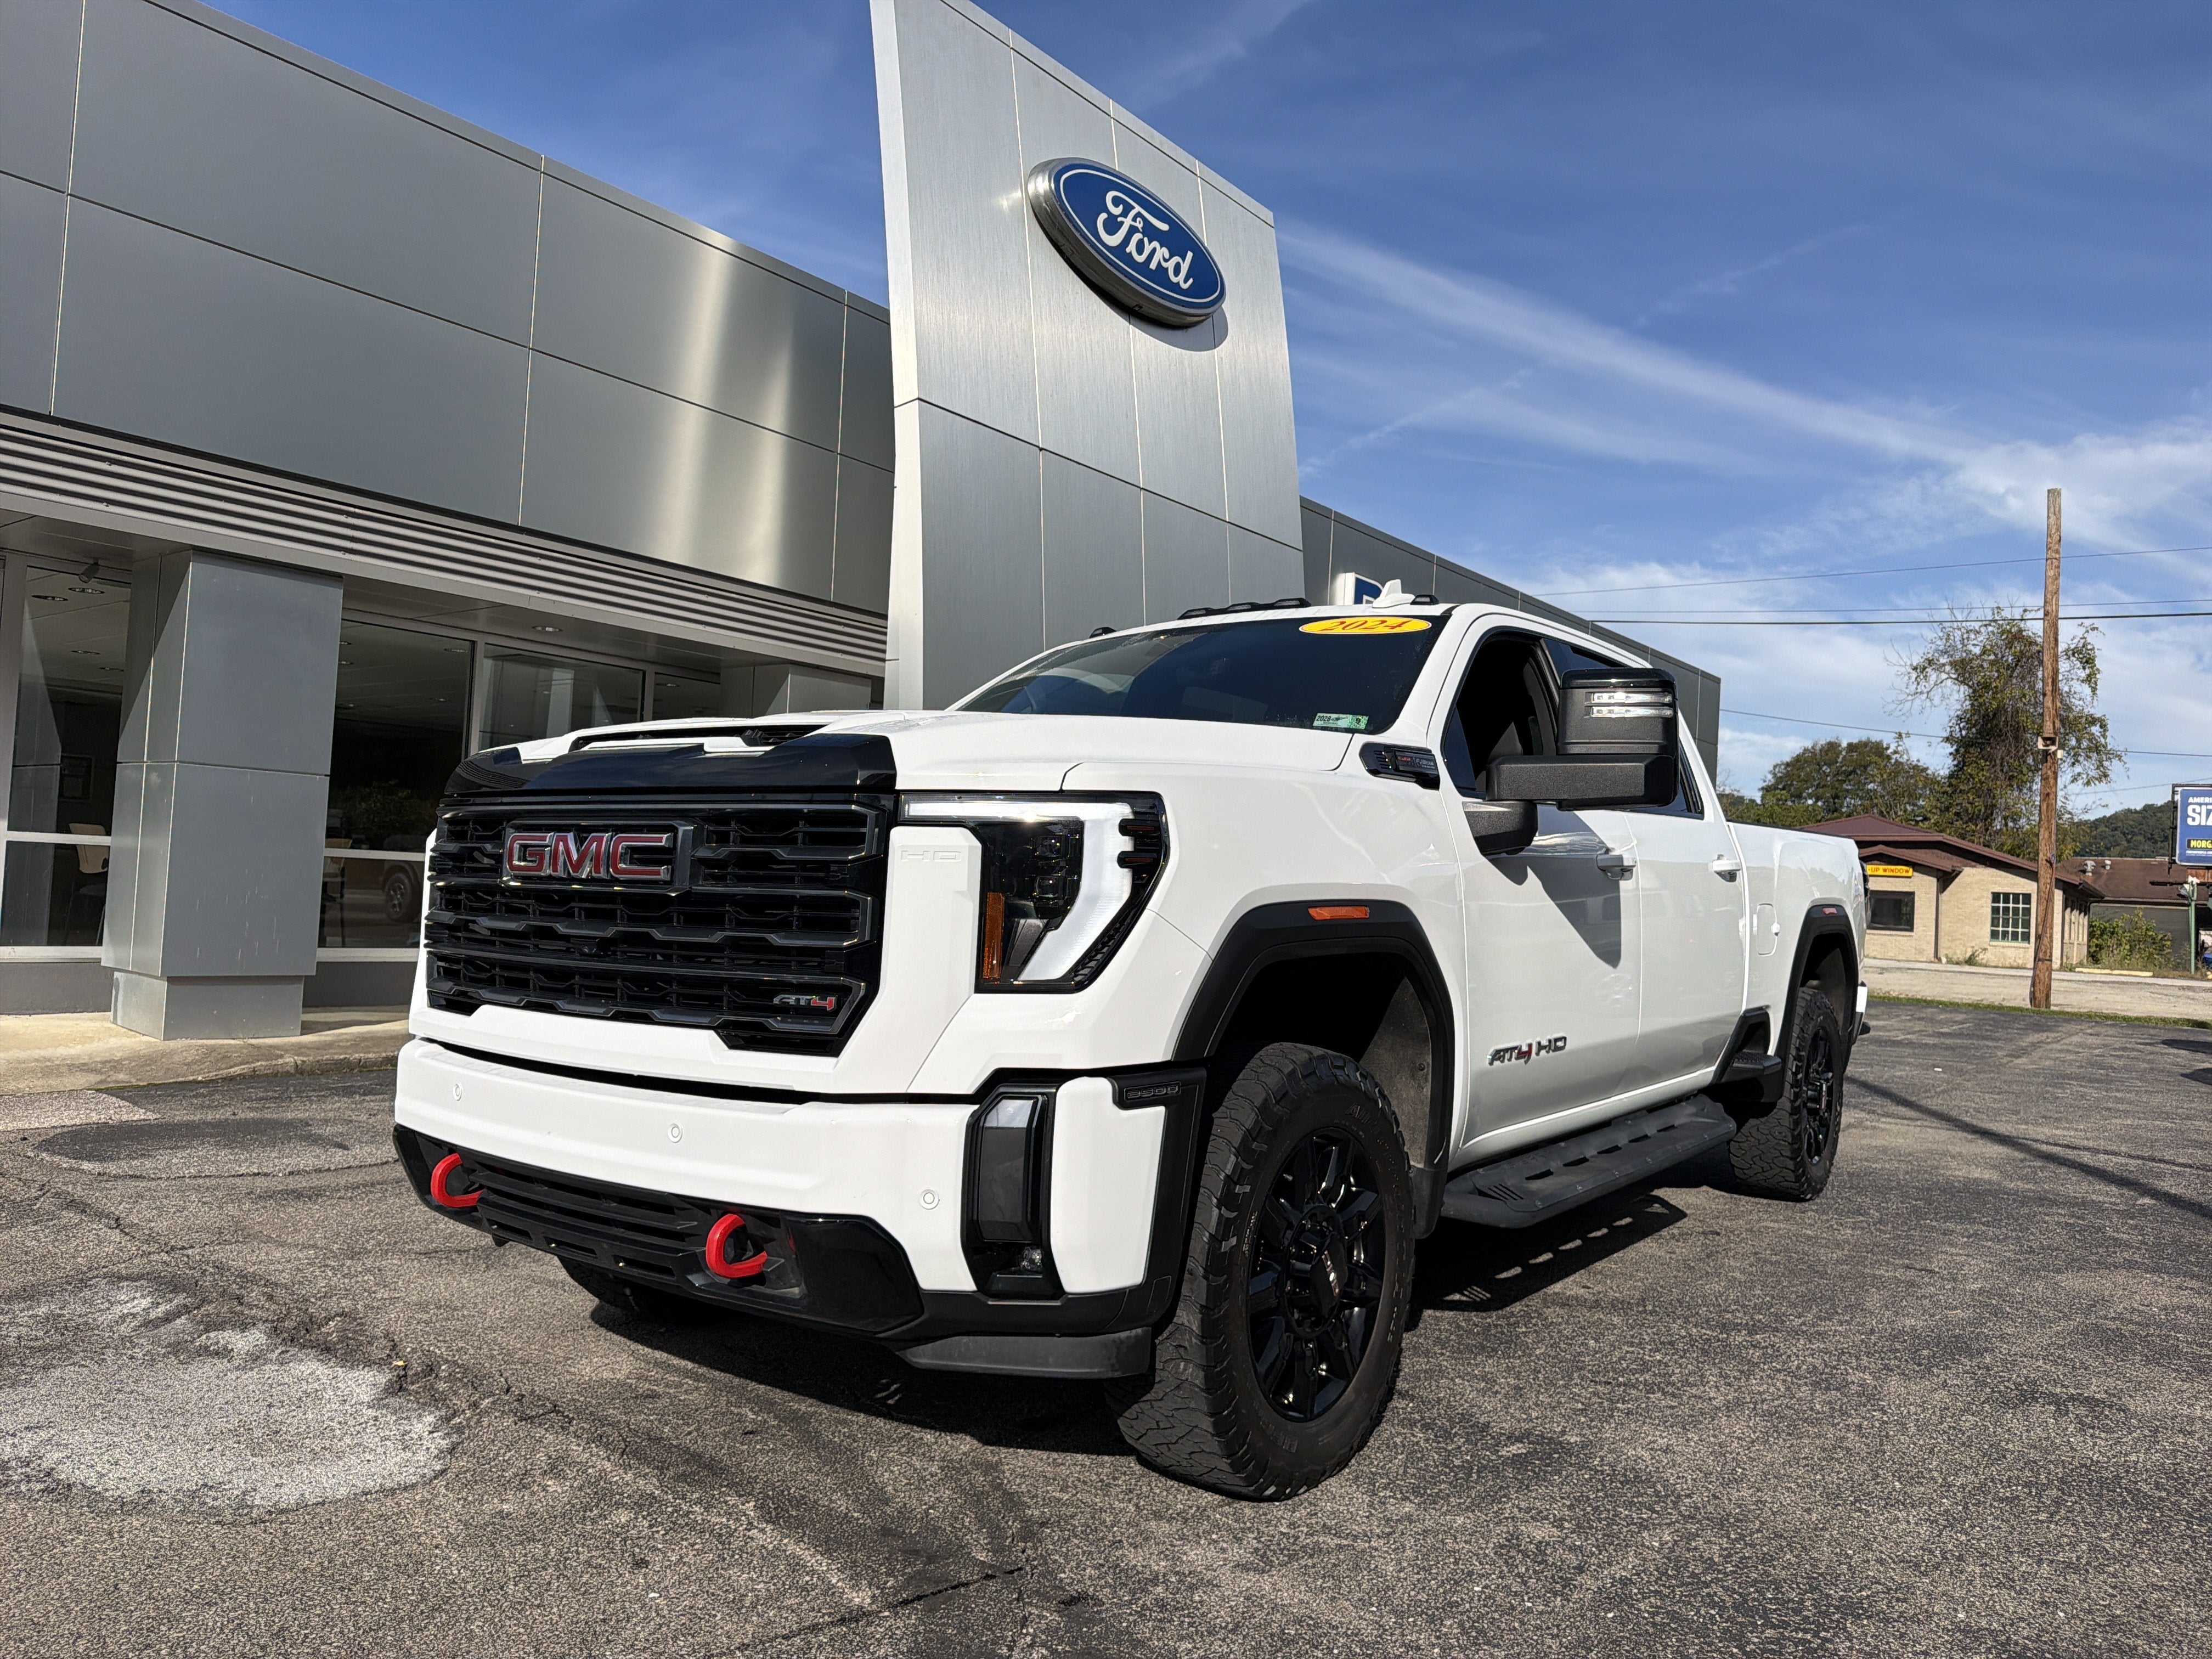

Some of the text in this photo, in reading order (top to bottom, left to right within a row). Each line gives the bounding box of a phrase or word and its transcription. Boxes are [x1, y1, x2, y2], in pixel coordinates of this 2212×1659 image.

[1097, 190, 1194, 290] Ford
[1318, 619, 1413, 631] 2024
[2191, 840, 2212, 848] MORG
[506, 832, 674, 881] GMC
[901, 850, 962, 862] HD
[773, 994, 837, 1011] AT4
[1487, 1036, 1567, 1066] AT4 HD
[1127, 1085, 1179, 1099] 2500
